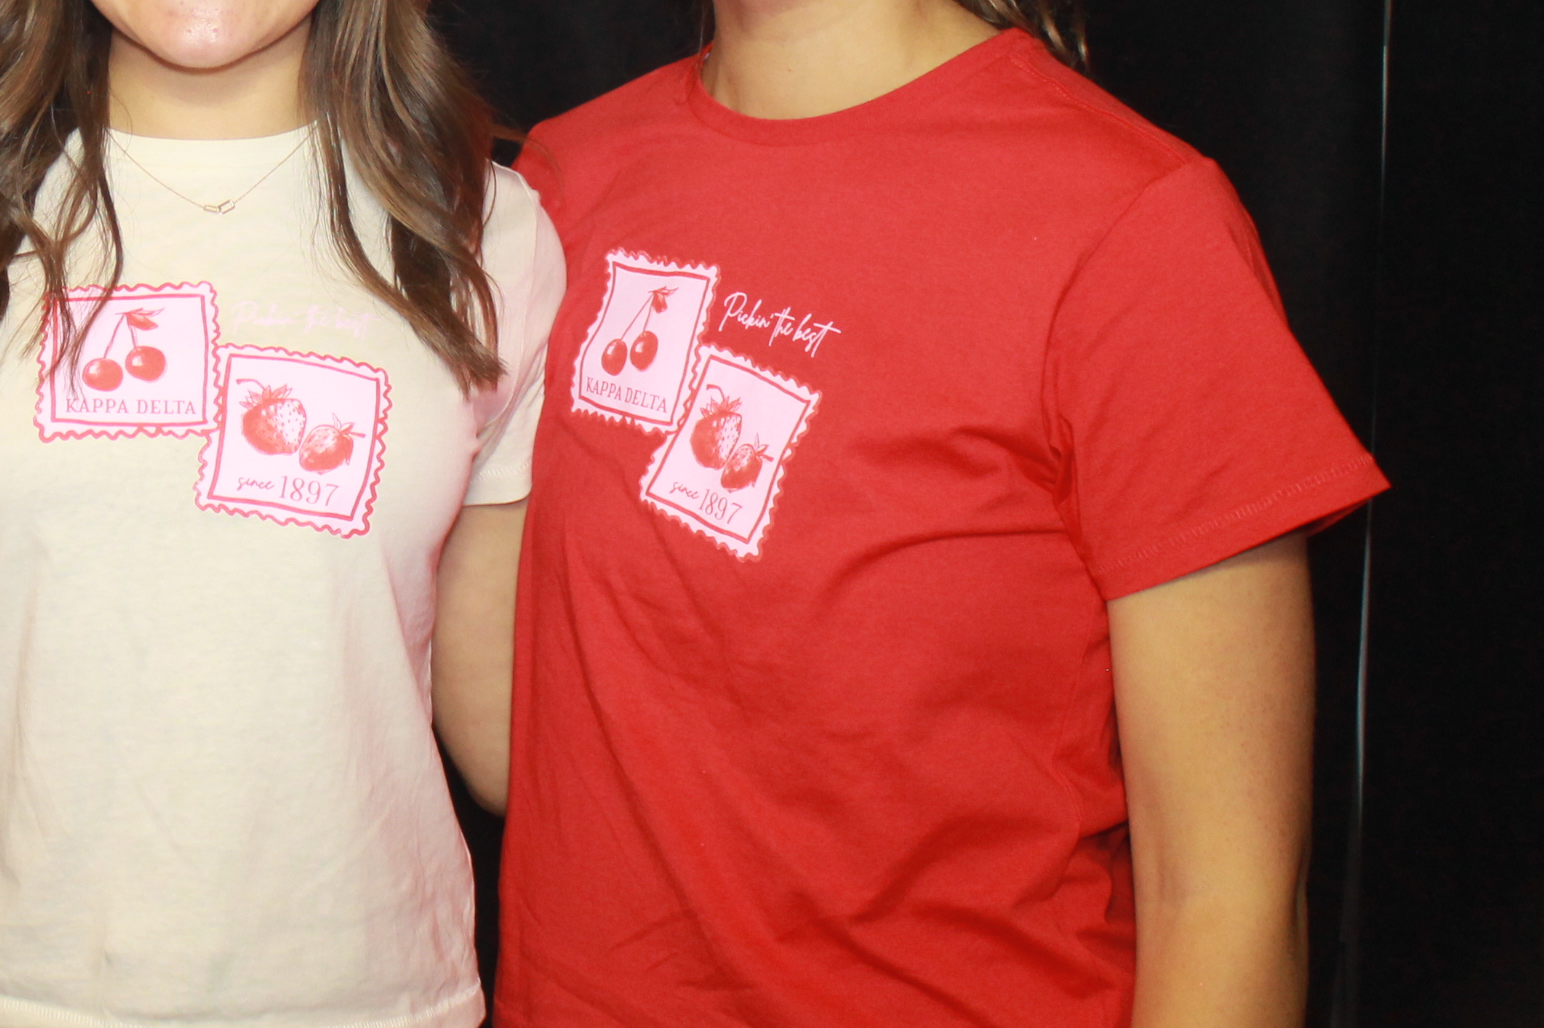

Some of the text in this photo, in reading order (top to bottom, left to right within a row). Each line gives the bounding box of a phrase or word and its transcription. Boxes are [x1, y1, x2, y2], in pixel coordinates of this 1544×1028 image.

[768, 307, 796, 347] the
[792, 313, 842, 358] best
[65, 398, 197, 415] KAPPA DELTA
[586, 377, 668, 413] KAPPA DELTA
[237, 476, 339, 506] since 1897
[669, 482, 743, 524] since 1897
